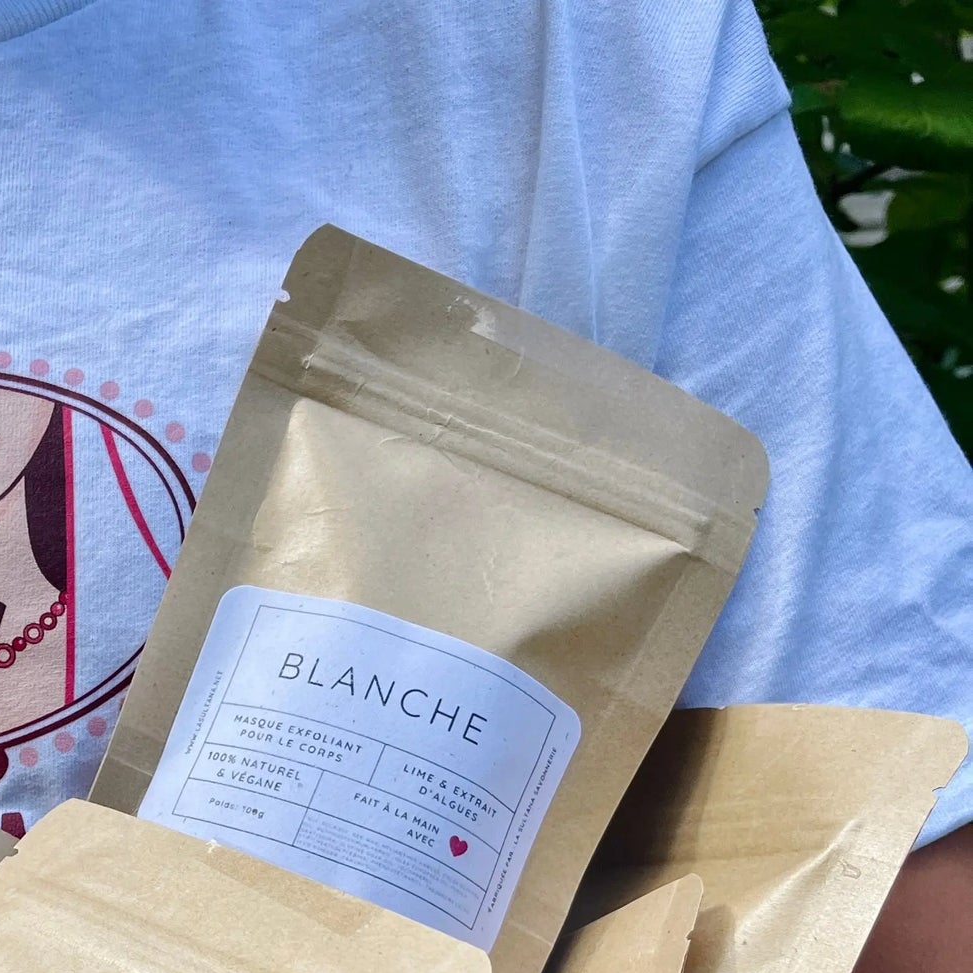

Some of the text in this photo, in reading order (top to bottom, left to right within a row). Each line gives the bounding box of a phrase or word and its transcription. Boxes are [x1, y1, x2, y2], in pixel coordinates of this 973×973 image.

[278, 652, 488, 746] BLANCHE
[233, 714, 363, 754] MASQUE EXFOLIANT
[239, 729, 344, 763] POUR LE CORPS
[207, 750, 301, 780] 100% NATUREL
[216, 768, 283, 792] & VÉGANE
[403, 764, 497, 818] LIME & EXTRAIT
[418, 786, 478, 822] D'ALGUES
[513, 834, 521, 845] LA
[518, 797, 535, 833] SULTANA
[533, 746, 558, 796] SAVONNERIE
[353, 792, 440, 835] FAIT À LA MAIN
[406, 829, 436, 848] AVEC
